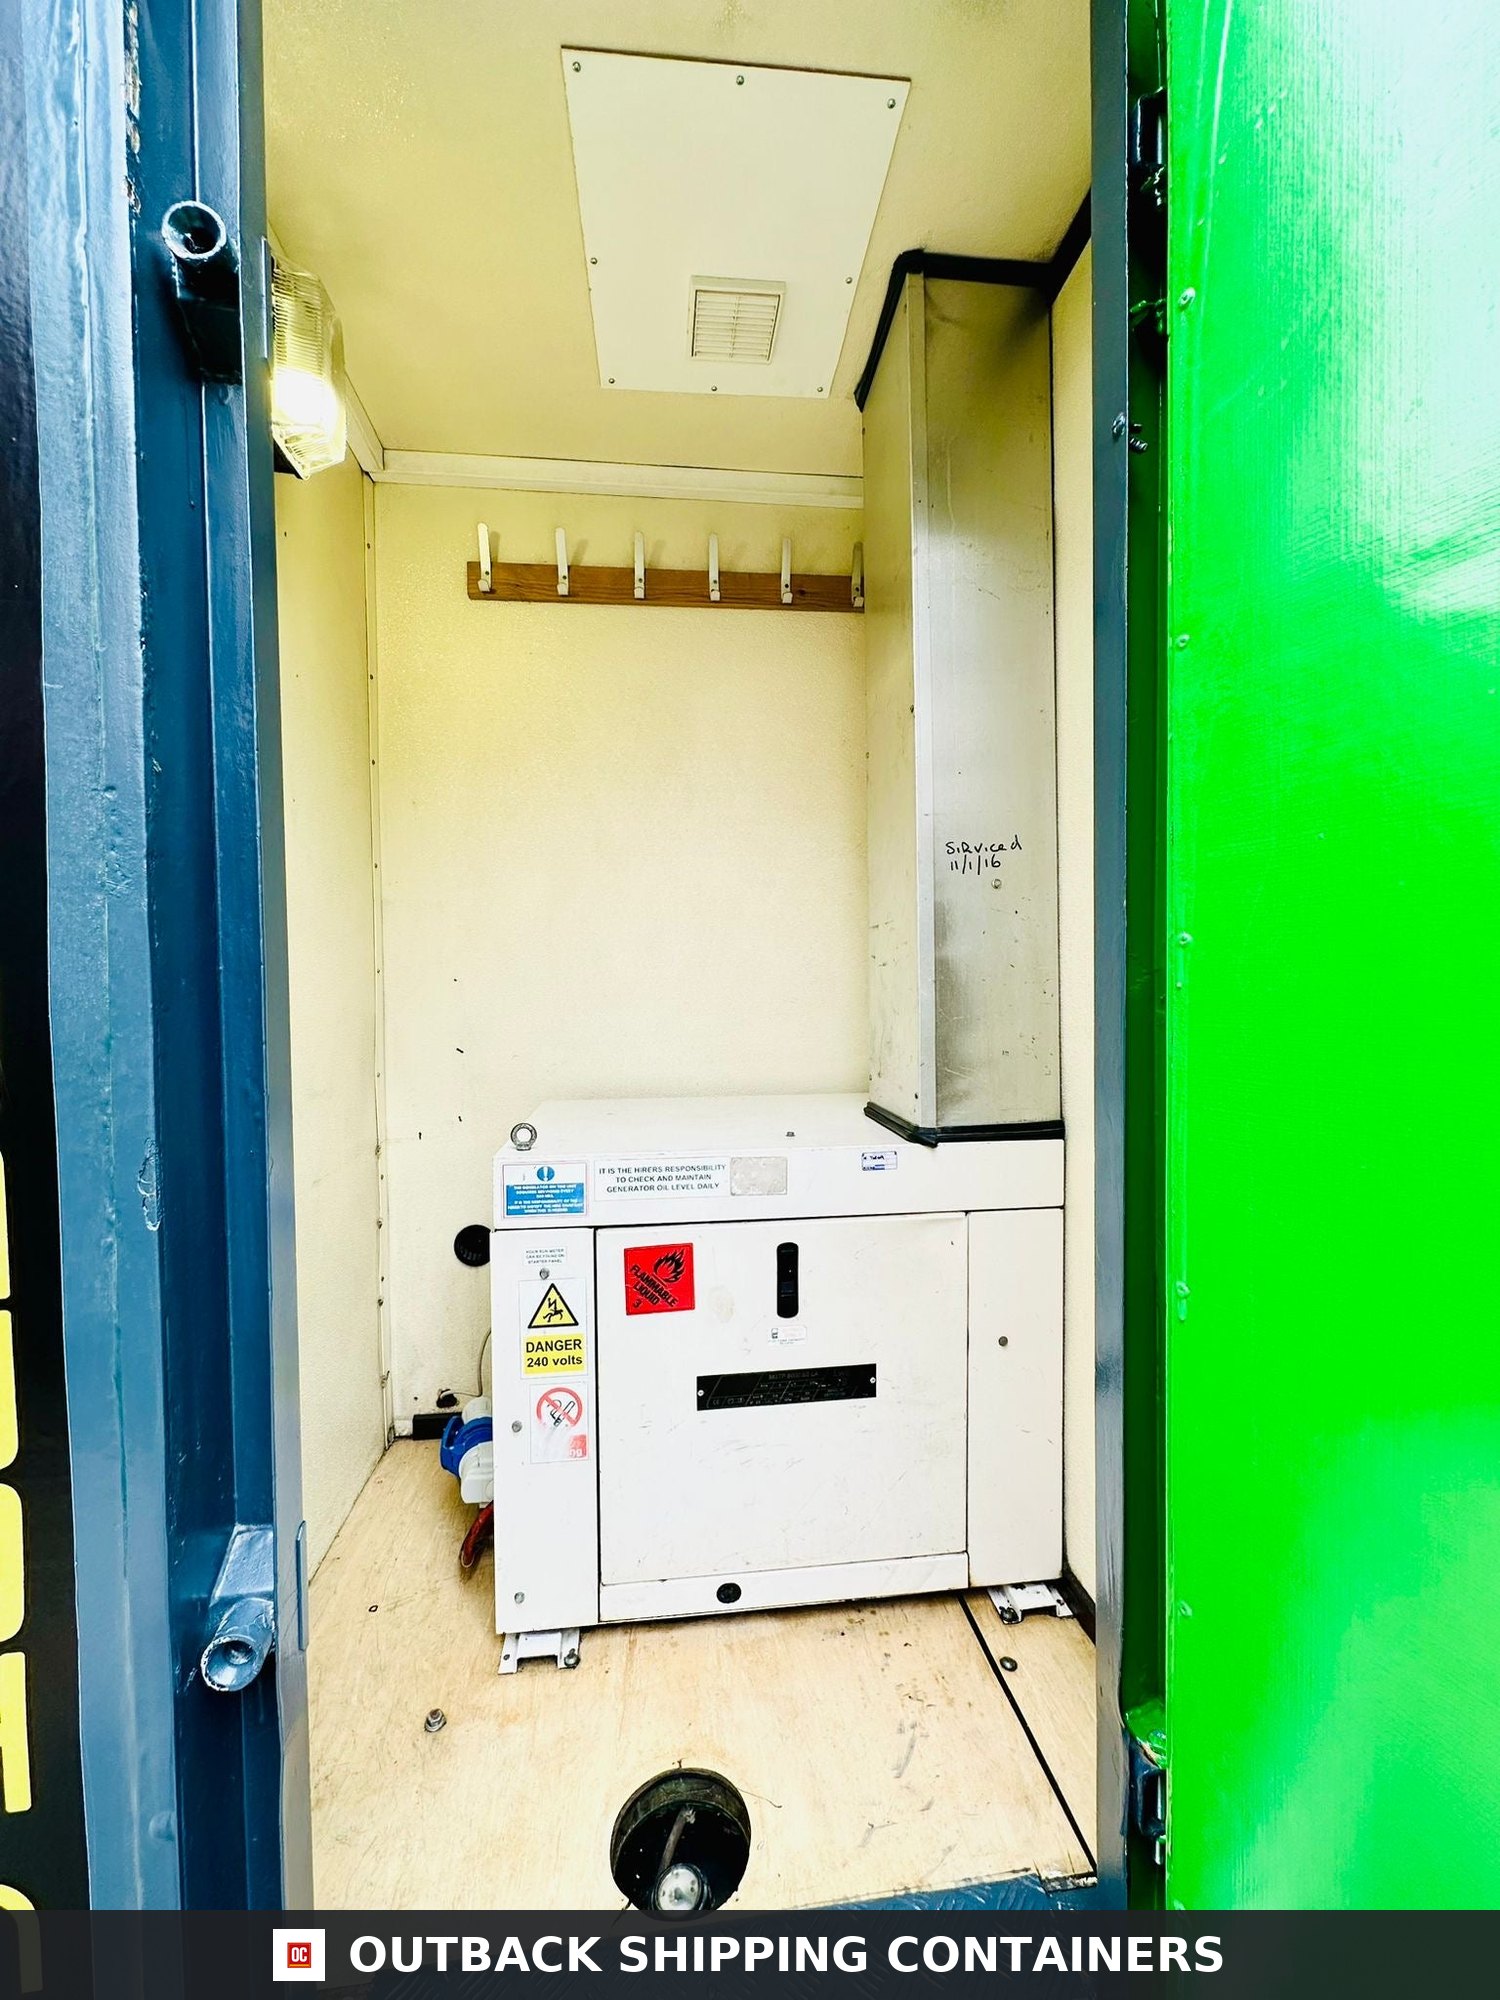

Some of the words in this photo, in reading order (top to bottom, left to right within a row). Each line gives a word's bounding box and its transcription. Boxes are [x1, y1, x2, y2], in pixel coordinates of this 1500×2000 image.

[951, 854, 1001, 875] 11/1/16
[665, 1164, 726, 1172] RESPONSIBILITY
[628, 1175, 655, 1183] CHECK
[606, 1184, 655, 1193] GENERATOR
[630, 1264, 678, 1307] FLAMMABLE
[633, 1281, 660, 1306] LIQUID
[633, 1298, 642, 1308] 3
[526, 1338, 582, 1353] DANGER
[527, 1356, 548, 1367] 240
[553, 1355, 582, 1366] volts
